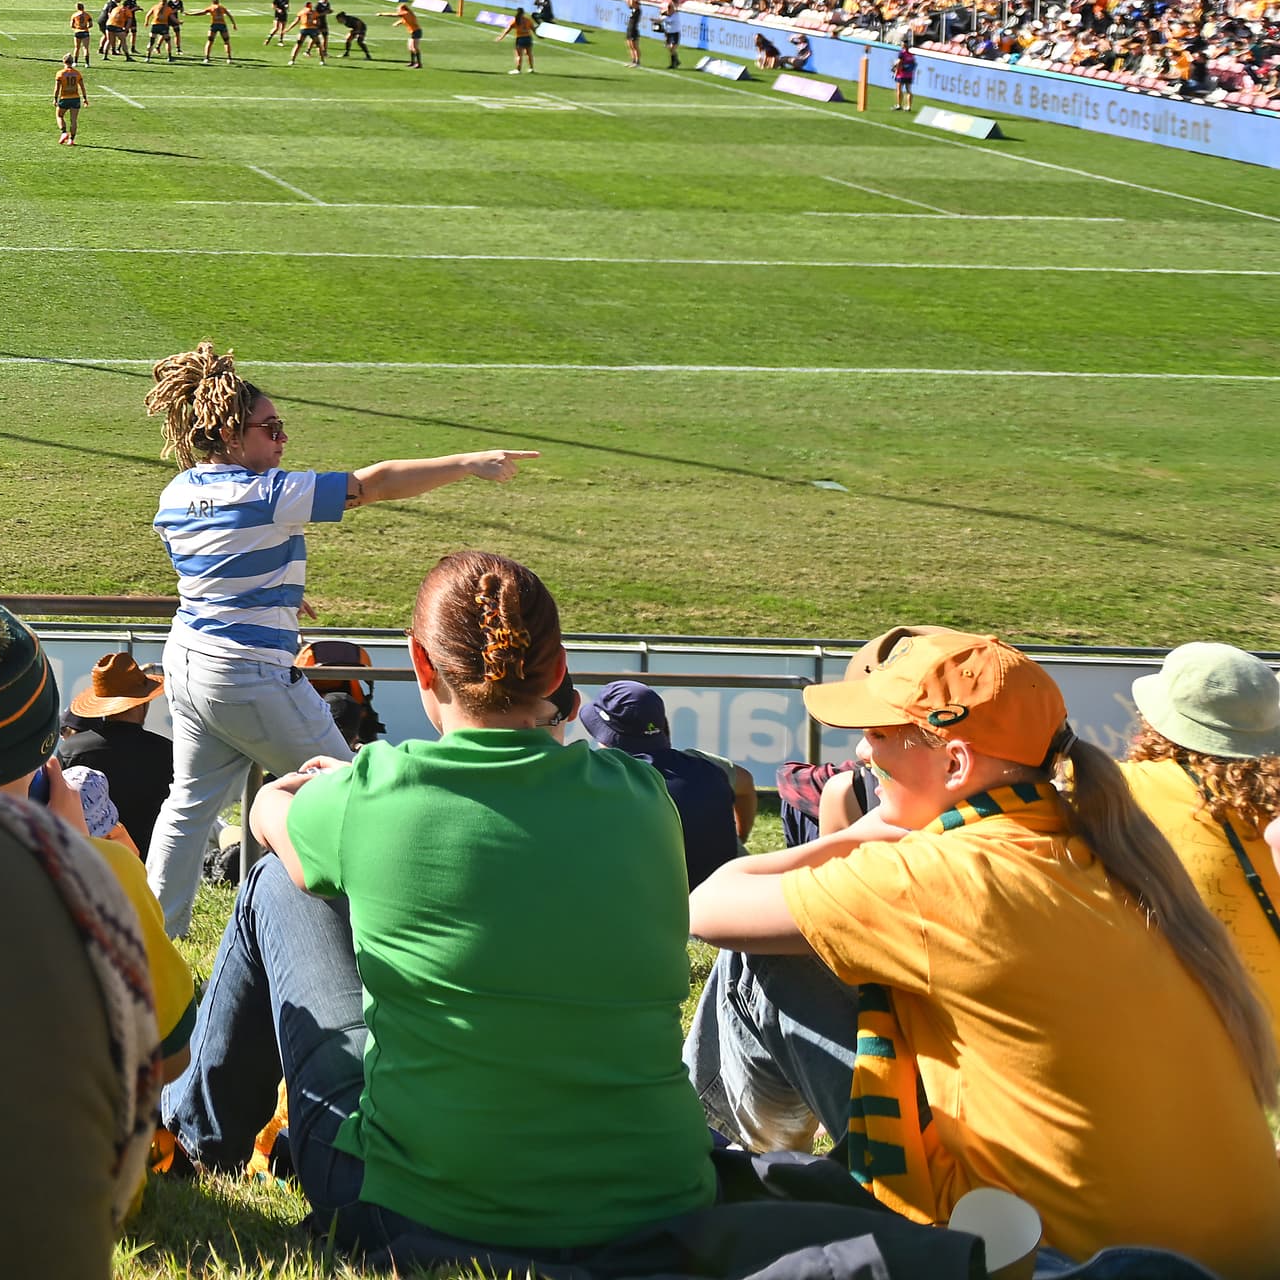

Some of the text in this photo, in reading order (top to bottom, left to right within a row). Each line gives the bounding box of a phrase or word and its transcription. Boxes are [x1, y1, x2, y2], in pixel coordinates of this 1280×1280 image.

[682, 24, 715, 43] enefits
[928, 66, 982, 99] Trusted
[987, 78, 1008, 102] HR
[1013, 85, 1023, 104] &
[1030, 86, 1100, 121] Benefits
[1107, 100, 1212, 144] Consultant
